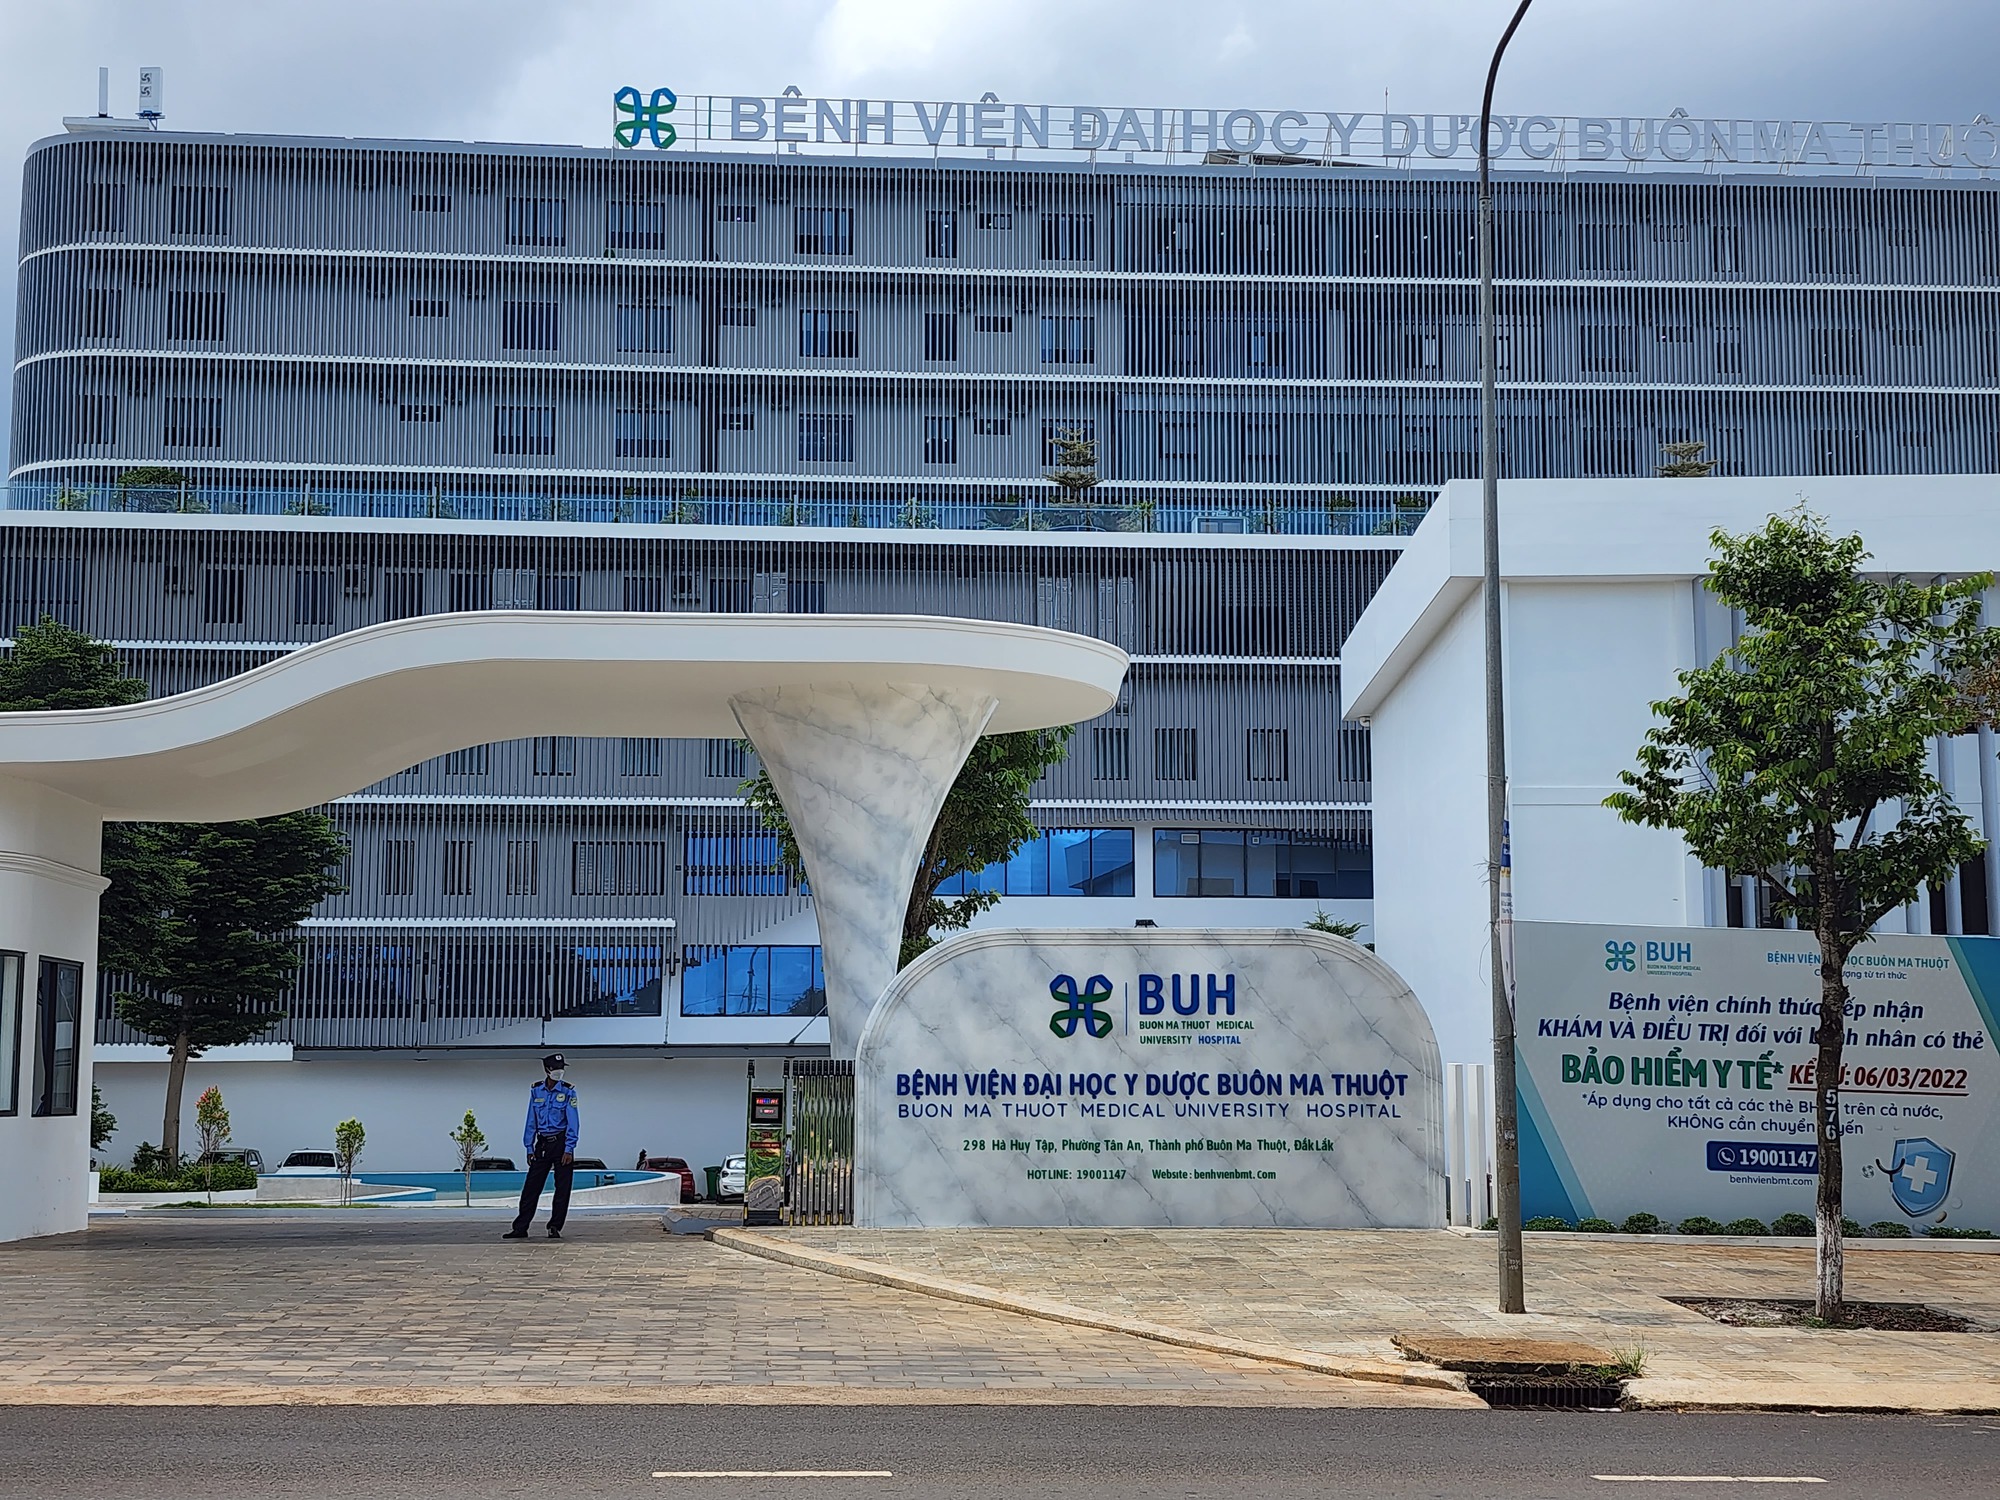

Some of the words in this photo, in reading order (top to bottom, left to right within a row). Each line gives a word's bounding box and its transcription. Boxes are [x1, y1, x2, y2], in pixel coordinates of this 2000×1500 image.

[731, 86, 894, 153] BỆNH
[913, 92, 1049, 158] VIỆN
[1069, 106, 1163, 162] ĐẠI
[1183, 109, 1309, 165] HỌC
[1333, 113, 1365, 156] Y
[1383, 114, 1557, 170] DƯỢC
[1579, 107, 1738, 162] BUÔN
[1753, 121, 1839, 165] MA
[1646, 941, 1692, 963] BUH
[1767, 951, 1795, 965] BỆNH
[1797, 952, 1820, 966] VIỆN
[1866, 954, 1896, 967] BUÔN
[1898, 957, 1914, 967] MA
[1916, 956, 1950, 970] THUỘT
[1888, 971, 1908, 980] thức
[1139, 974, 1235, 1015] BUH
[1608, 992, 1661, 1014] Bệnh
[1668, 995, 1709, 1016] viện
[1716, 996, 1771, 1014] chính
[1779, 997, 1821, 1015] thức
[1843, 997, 1866, 1021] ếp
[1873, 1001, 1924, 1022] nhận
[1139, 1021, 1164, 1029] BUON
[1165, 1021, 1179, 1029] MA
[1181, 1021, 1211, 1029] THUOT
[1216, 1021, 1254, 1029] MEDICAL
[1538, 1015, 1602, 1038] KHÁM
[1609, 1016, 1636, 1039] VÀ
[1643, 1014, 1692, 1041] ĐIỀU
[1698, 1023, 1729, 1046] TRỊ
[1735, 1022, 1767, 1043] đối
[1773, 1026, 1803, 1044] với
[1866, 1030, 1916, 1048] nhân
[1923, 1032, 1946, 1048] có
[1953, 1031, 1984, 1049] thẻ
[1140, 1035, 1192, 1044] UNIVERSITY
[1198, 1035, 1241, 1044] HOSPITAL
[1561, 1046, 1625, 1085] BẢO
[1631, 1046, 1707, 1088] HIỂM
[1712, 1059, 1733, 1089] Y
[1789, 1057, 1818, 1084] KỂ
[1854, 1066, 1968, 1089] 06/03/2022
[897, 1069, 957, 1100] BỆNH
[965, 1069, 1016, 1100] VIỆN
[1024, 1073, 1061, 1100] ĐẠI
[1069, 1073, 1117, 1100] HỌC
[1124, 1074, 1138, 1096] Y
[1146, 1071, 1210, 1100] DƯỢC
[1217, 1069, 1282, 1096] BUÔN
[1290, 1074, 1324, 1096] MA
[1331, 1069, 1409, 1100] THUỘT
[898, 1103, 952, 1118] BUON
[964, 1103, 992, 1118] MA
[1002, 1103, 1068, 1118] THUOT
[1081, 1103, 1166, 1118] MEDICAL
[1175, 1103, 1290, 1118] UNIVERSITY
[1307, 1103, 1401, 1118] HOSPITAL
[1612, 1094, 1651, 1110] dụng
[1656, 1095, 1683, 1109] cho
[1688, 1095, 1711, 1110] tất
[1715, 1097, 1733, 1111] cả
[1738, 1097, 1765, 1111] các
[1769, 1098, 1794, 1113] thẻ
[1844, 1102, 1875, 1115] trên
[1880, 1103, 1898, 1116] cả
[1902, 1104, 1944, 1120] nước,
[1668, 1113, 1724, 1129] KHÔNG
[1729, 1114, 1756, 1131] cần
[1761, 1118, 1815, 1135] chuyển
[1837, 1119, 1864, 1136] yến
[963, 1139, 986, 1151] 298
[992, 1139, 1006, 1151] Hà
[1010, 1139, 1031, 1153] Huy
[1035, 1139, 1057, 1153] Tập,
[1062, 1139, 1101, 1153] Phường
[1104, 1139, 1123, 1151] Tân
[1126, 1139, 1144, 1153] An,
[1148, 1139, 1181, 1151] Thành
[1185, 1138, 1204, 1153] phố
[1206, 1139, 1233, 1151] Buôn
[1237, 1139, 1252, 1151] Ma
[1257, 1139, 1291, 1153] Thuột,
[1739, 1149, 1817, 1168] 19001147
[1027, 1169, 1072, 1180] HOTLINE:
[1076, 1169, 1127, 1180] 19001147
[1730, 1175, 1813, 1186] benhvienbmt.com
